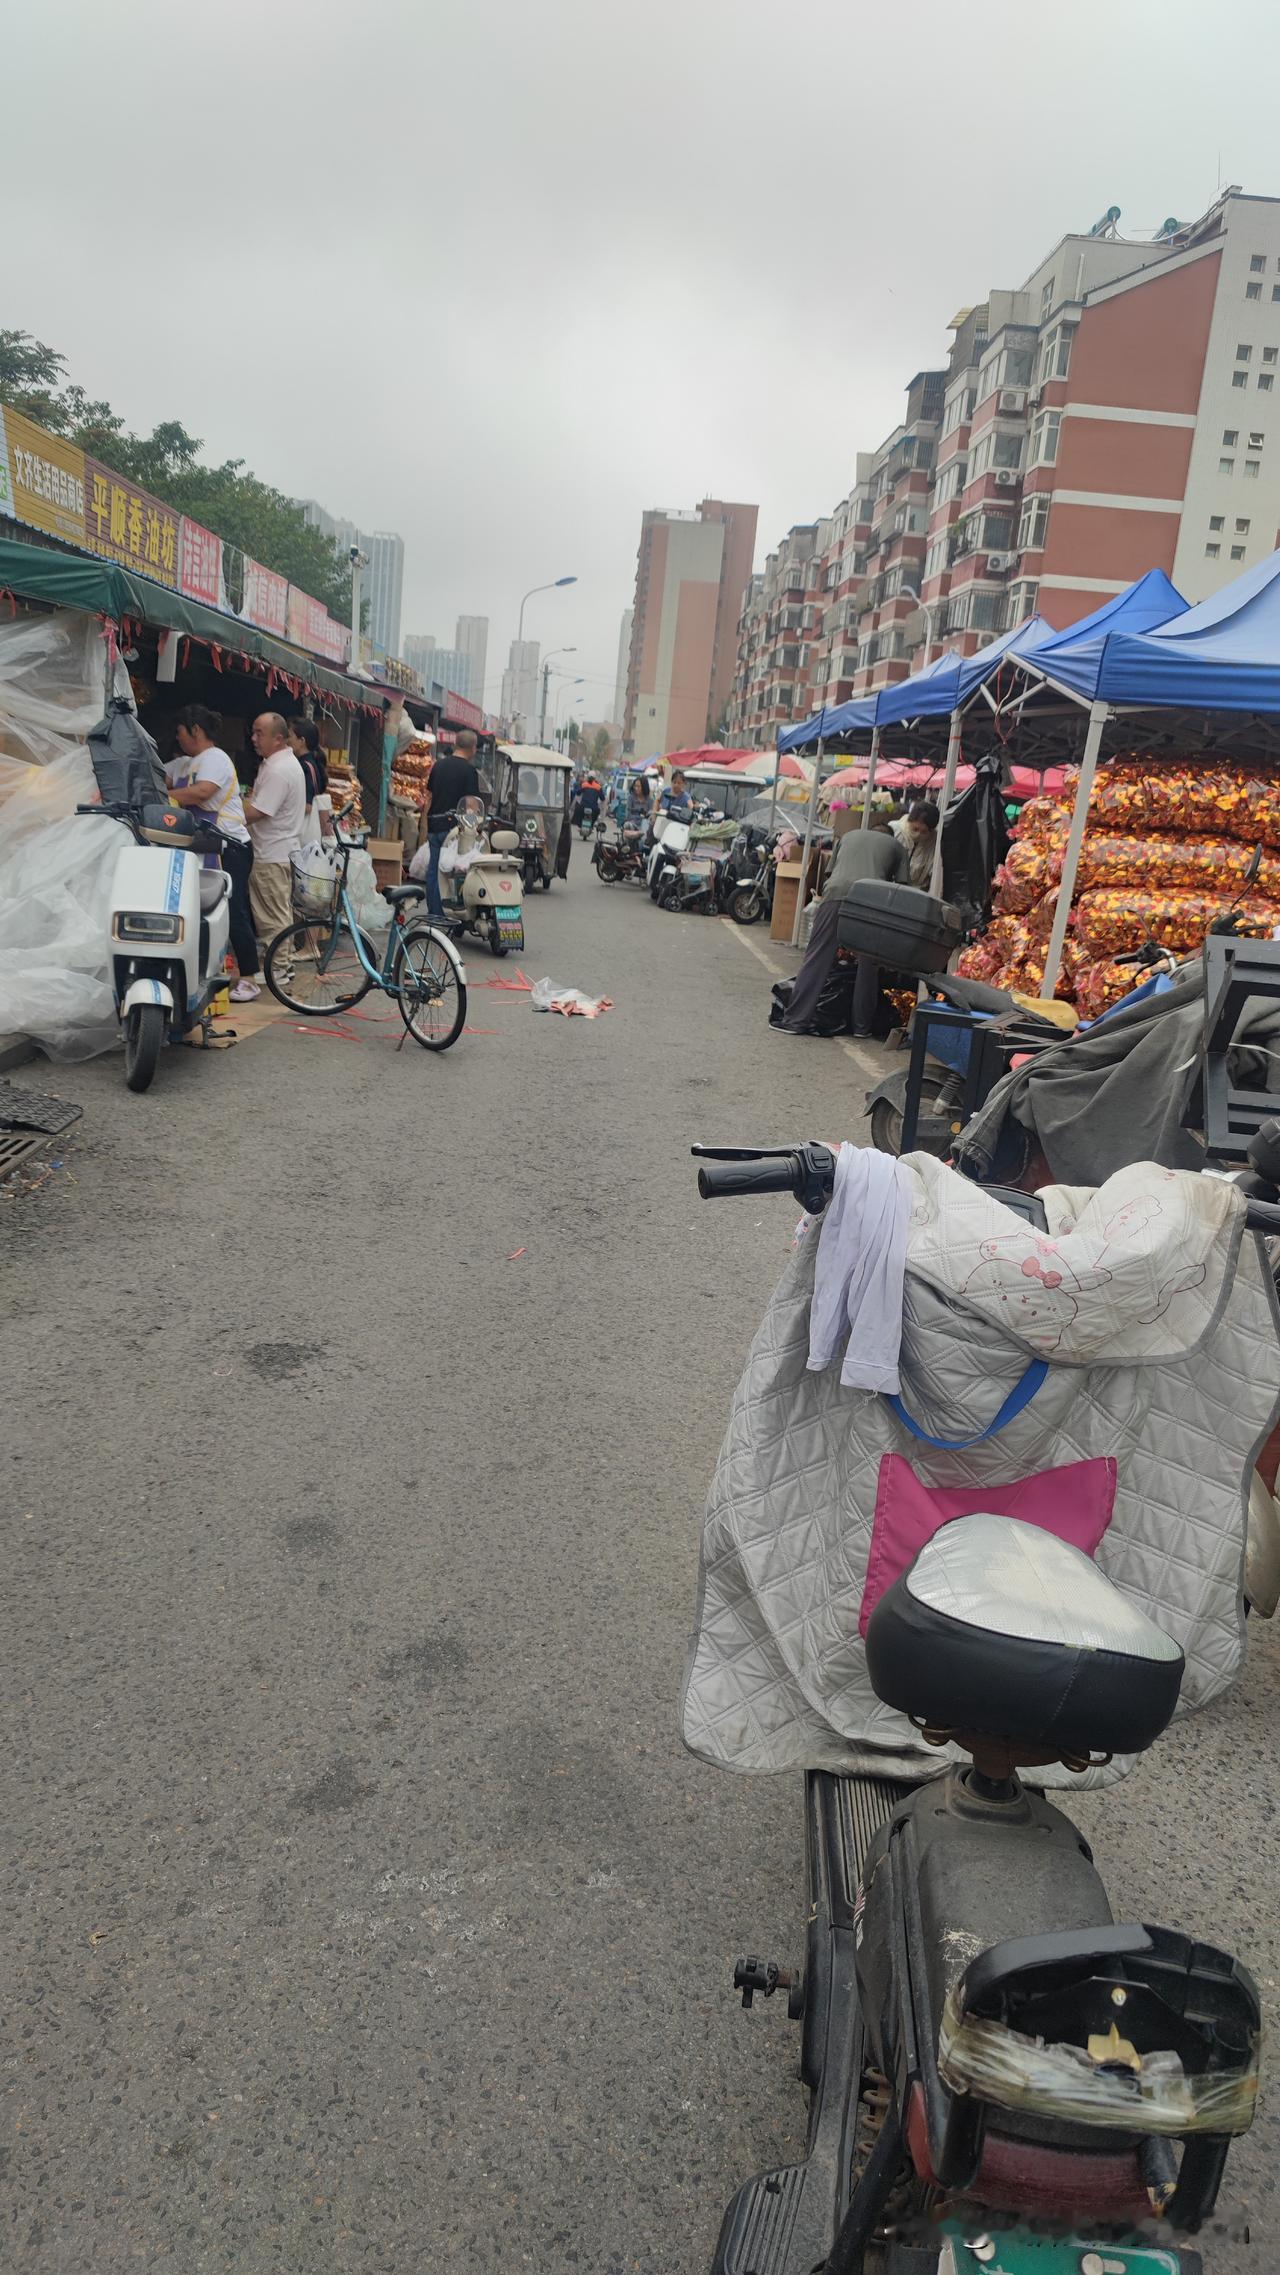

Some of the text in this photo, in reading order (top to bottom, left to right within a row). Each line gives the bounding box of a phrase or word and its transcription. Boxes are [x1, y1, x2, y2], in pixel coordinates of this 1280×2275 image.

[90, 472, 176, 571] 平顺香油坊
